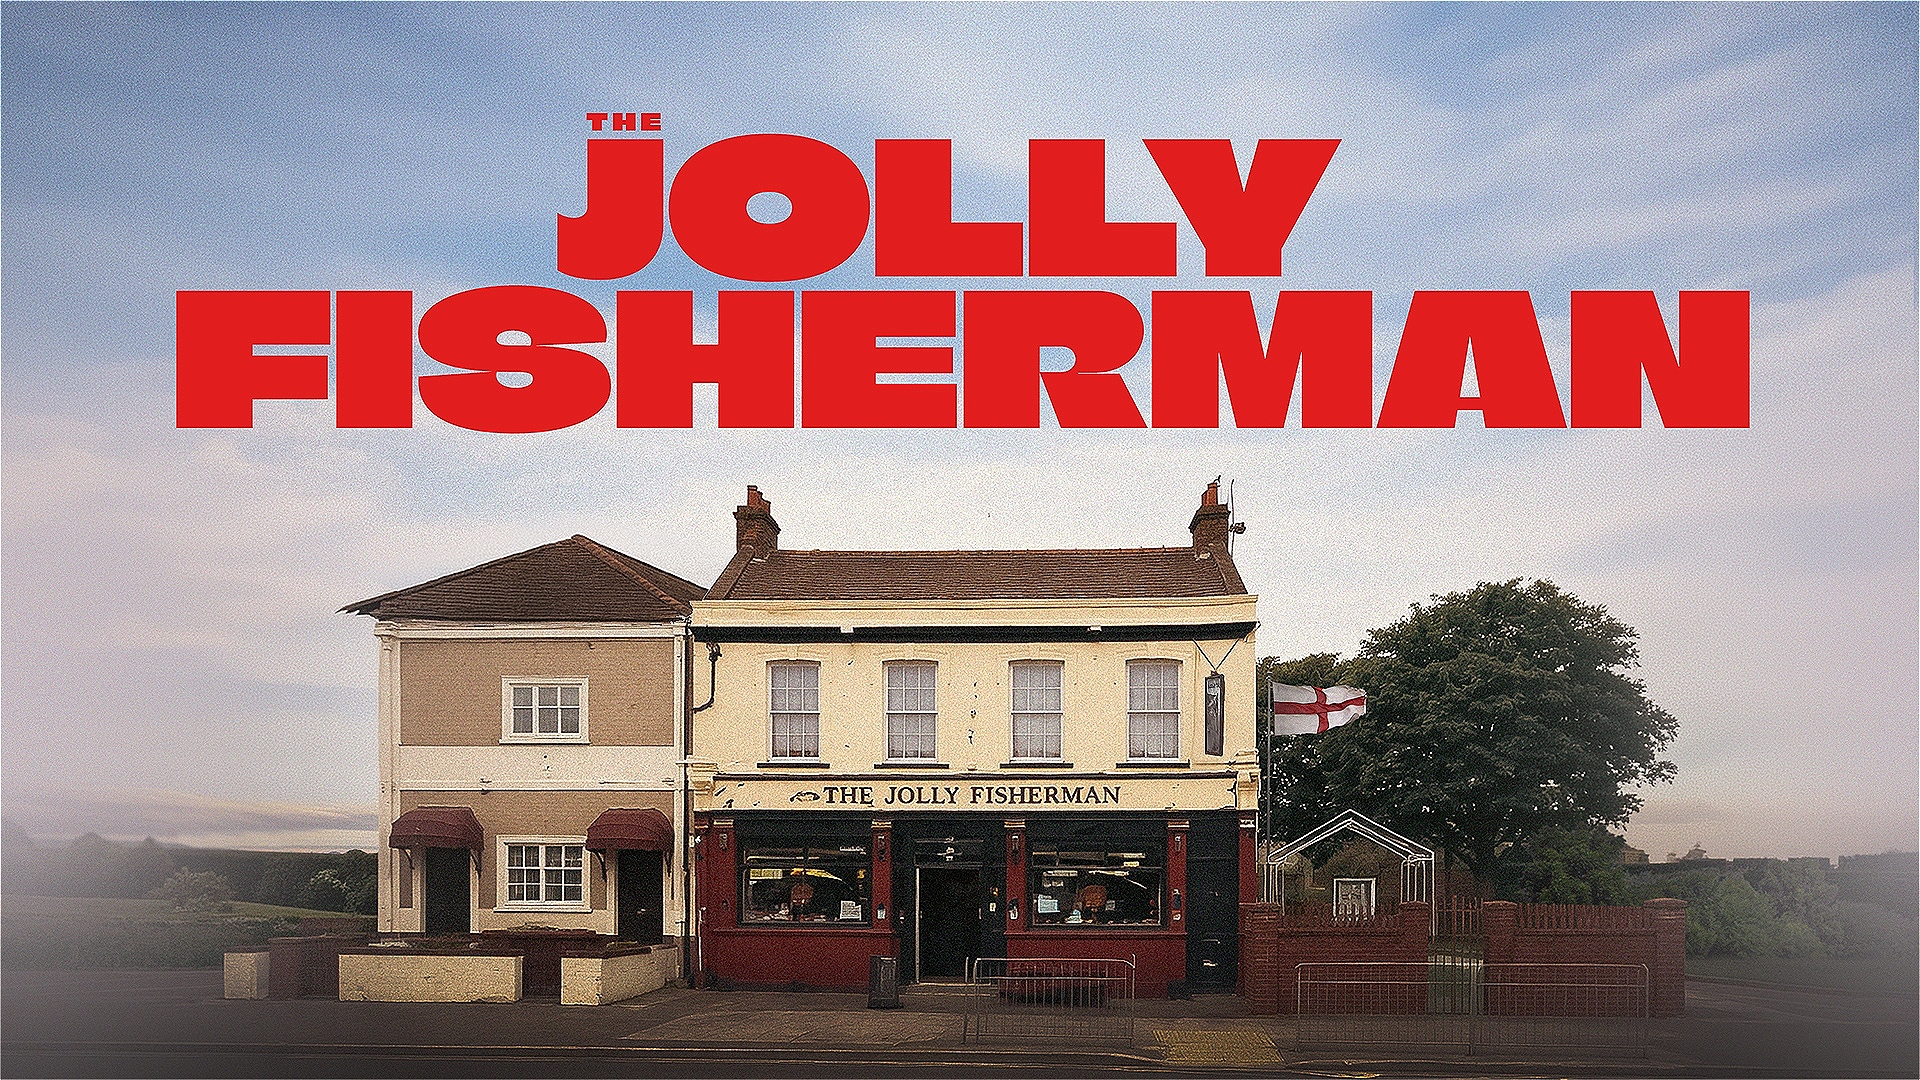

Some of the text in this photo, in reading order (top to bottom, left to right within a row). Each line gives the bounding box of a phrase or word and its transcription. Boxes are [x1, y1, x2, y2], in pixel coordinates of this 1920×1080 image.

[823, 786, 1122, 806] THE JOLLY FISHERMAN
